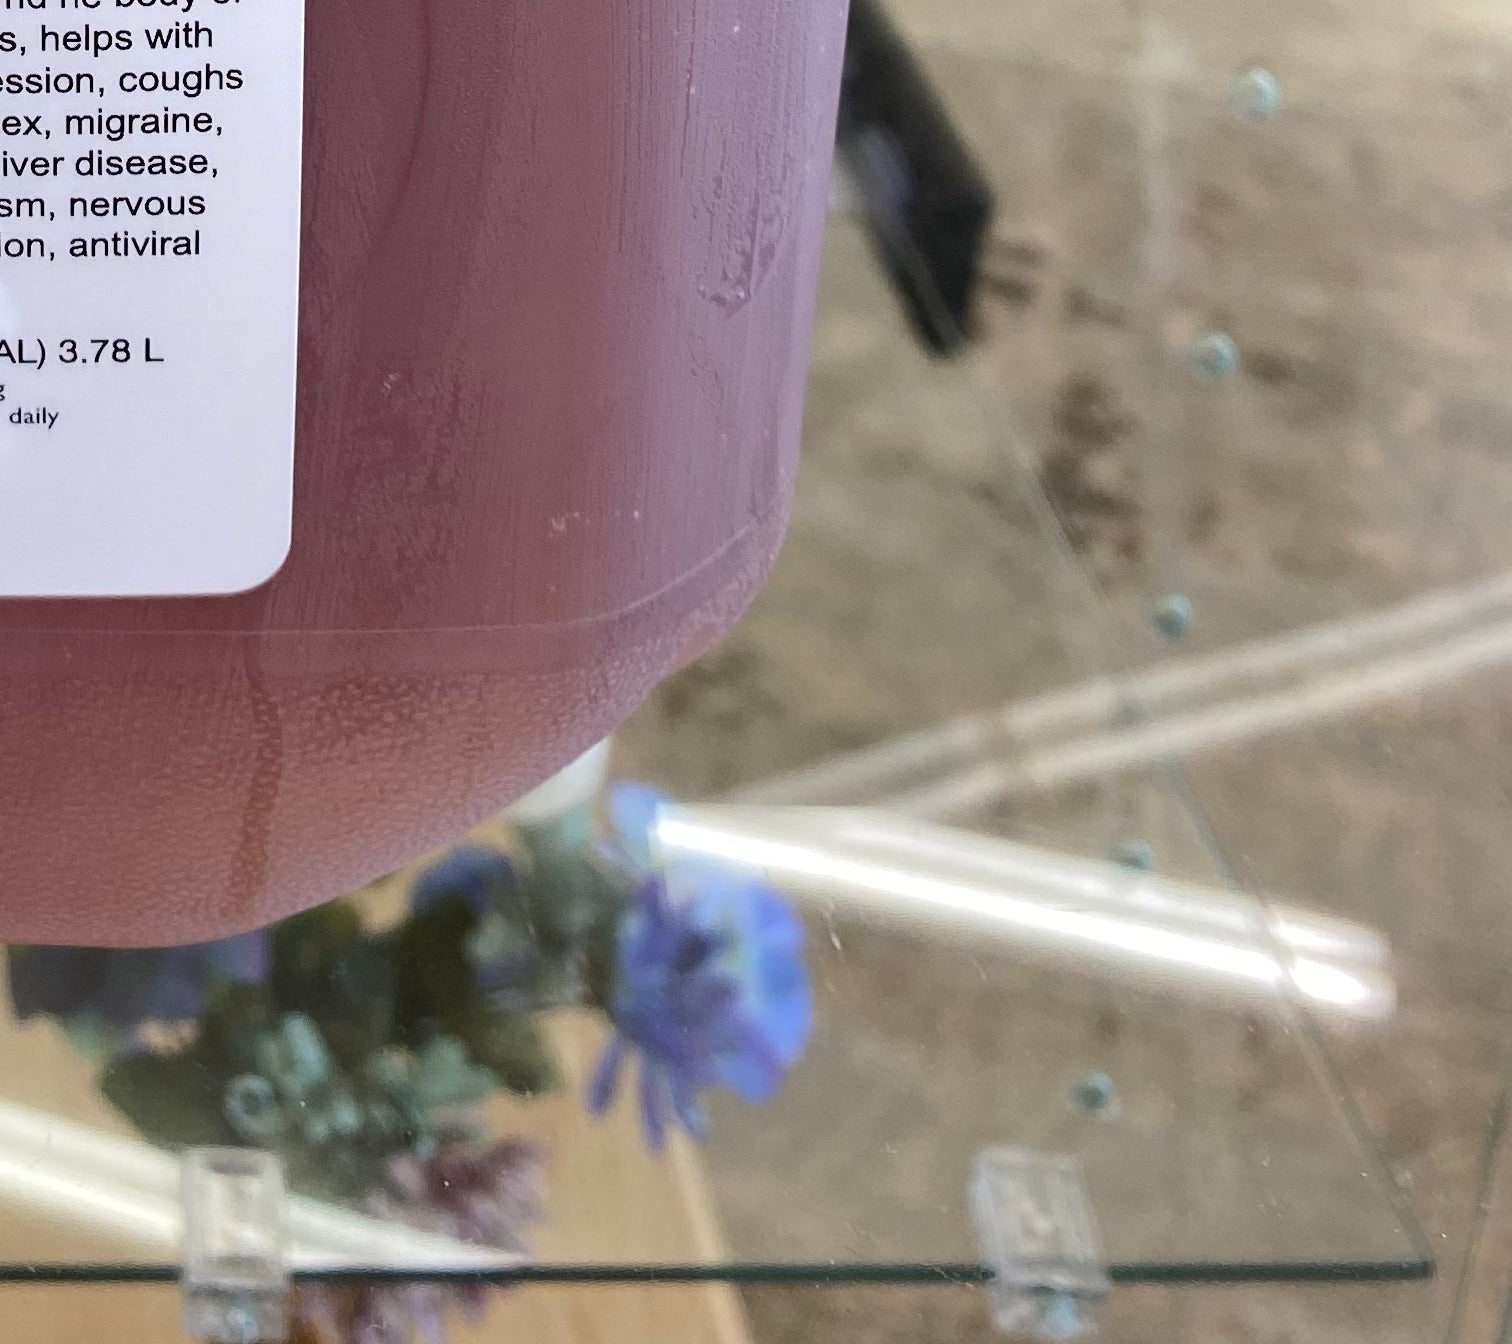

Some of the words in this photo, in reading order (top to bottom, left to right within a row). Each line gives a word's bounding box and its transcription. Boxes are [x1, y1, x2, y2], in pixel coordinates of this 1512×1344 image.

[40, 23, 134, 59] helps
[143, 19, 213, 51] with
[118, 62, 244, 100] coughs
[65, 104, 223, 143] migraine,
[74, 148, 218, 179] disease,
[69, 194, 207, 218] nervous
[68, 228, 200, 258] antiviral
[58, 337, 131, 365] 3.78
[144, 336, 165, 363] L
[8, 405, 60, 431] daily
